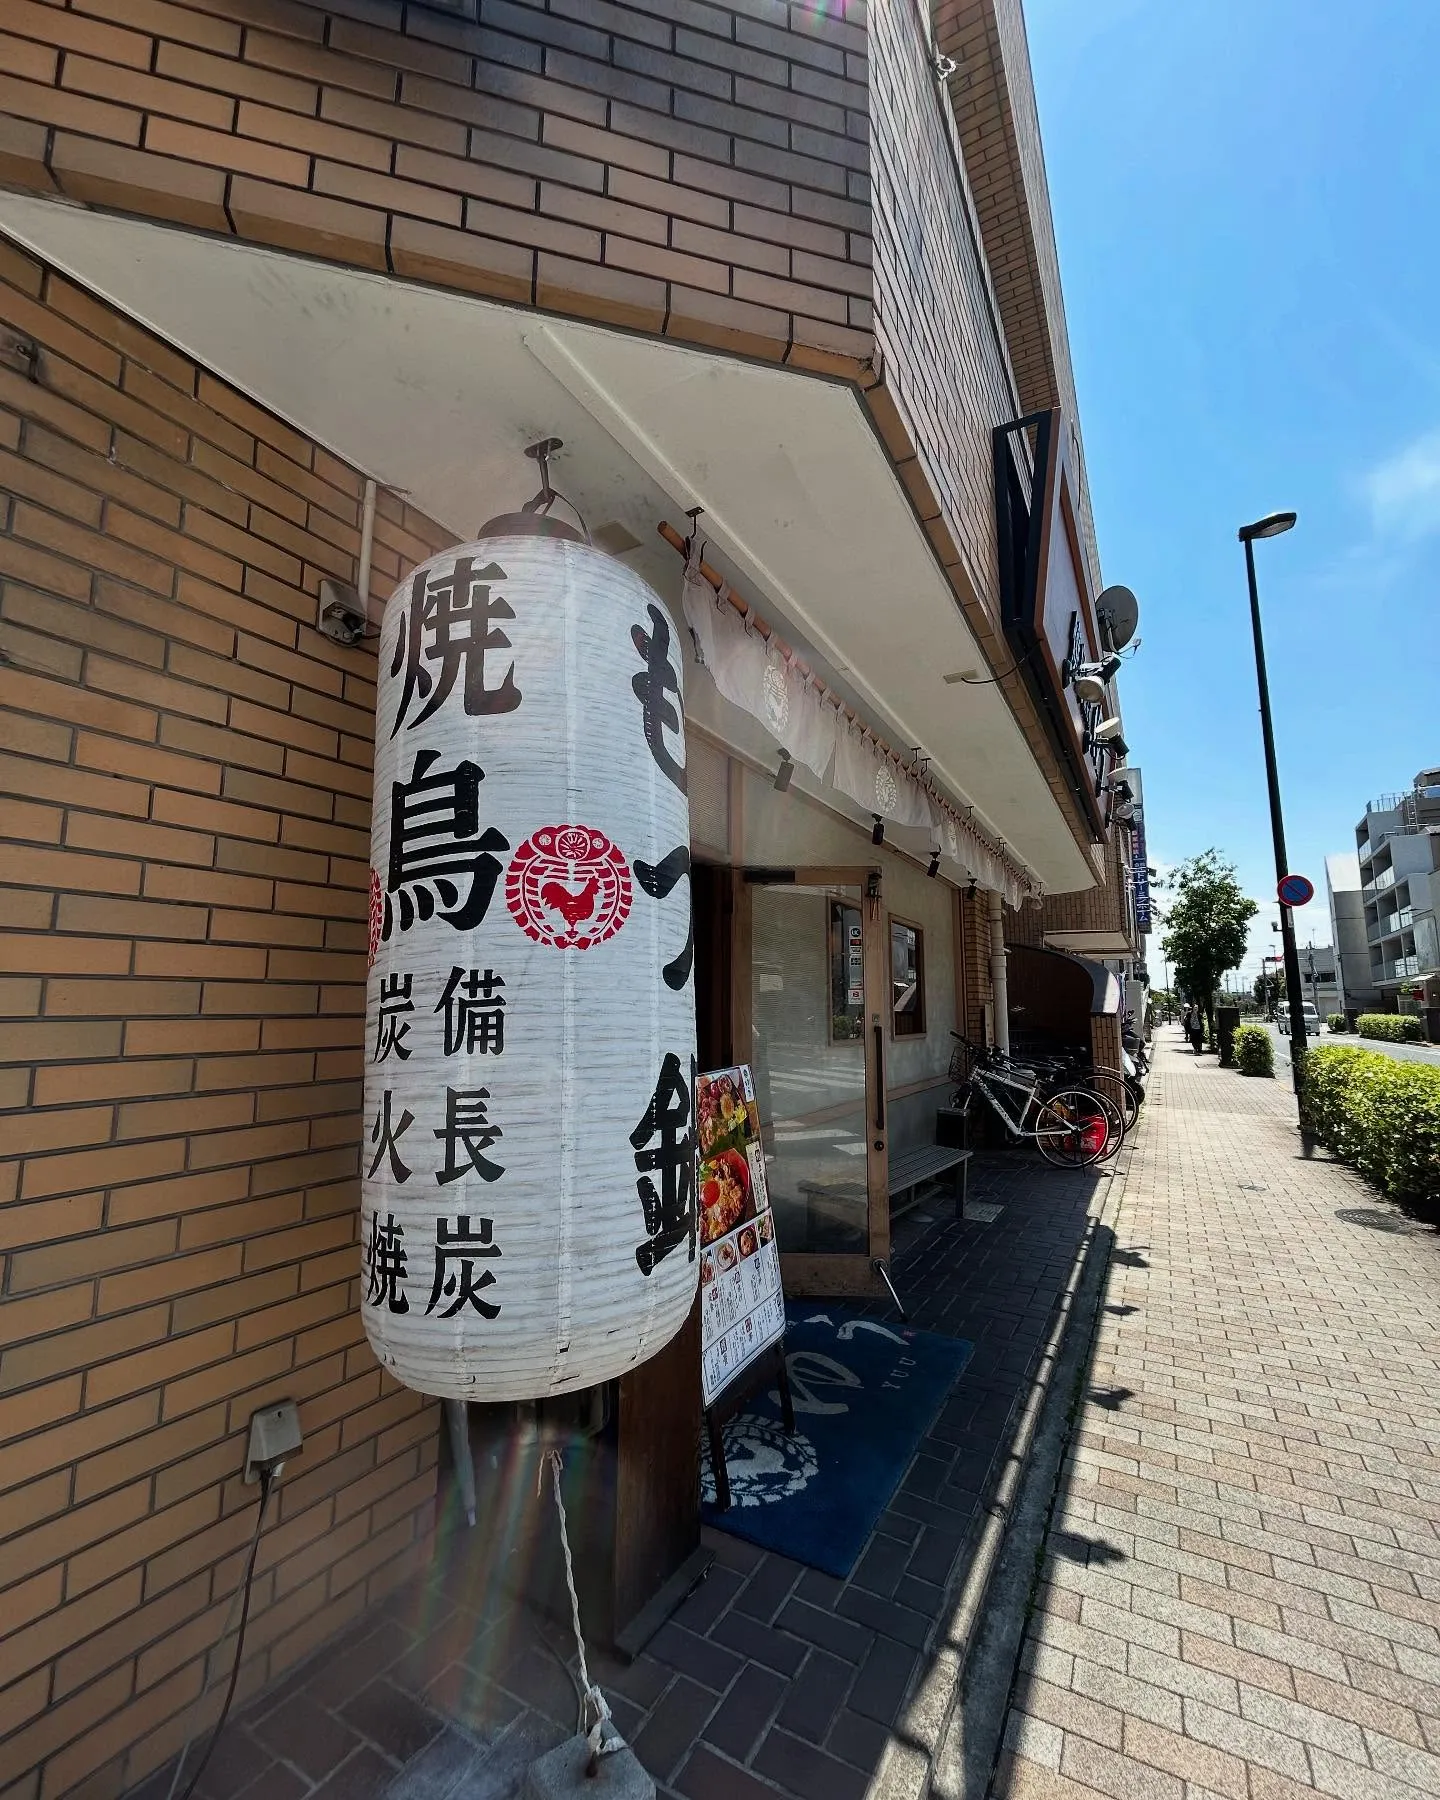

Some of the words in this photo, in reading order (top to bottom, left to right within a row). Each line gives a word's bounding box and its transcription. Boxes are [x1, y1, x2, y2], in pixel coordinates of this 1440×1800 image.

[382, 556, 523, 942] 焼鳥
[366, 973, 416, 1314] 炭火焼
[424, 966, 507, 1319] 備長炭
